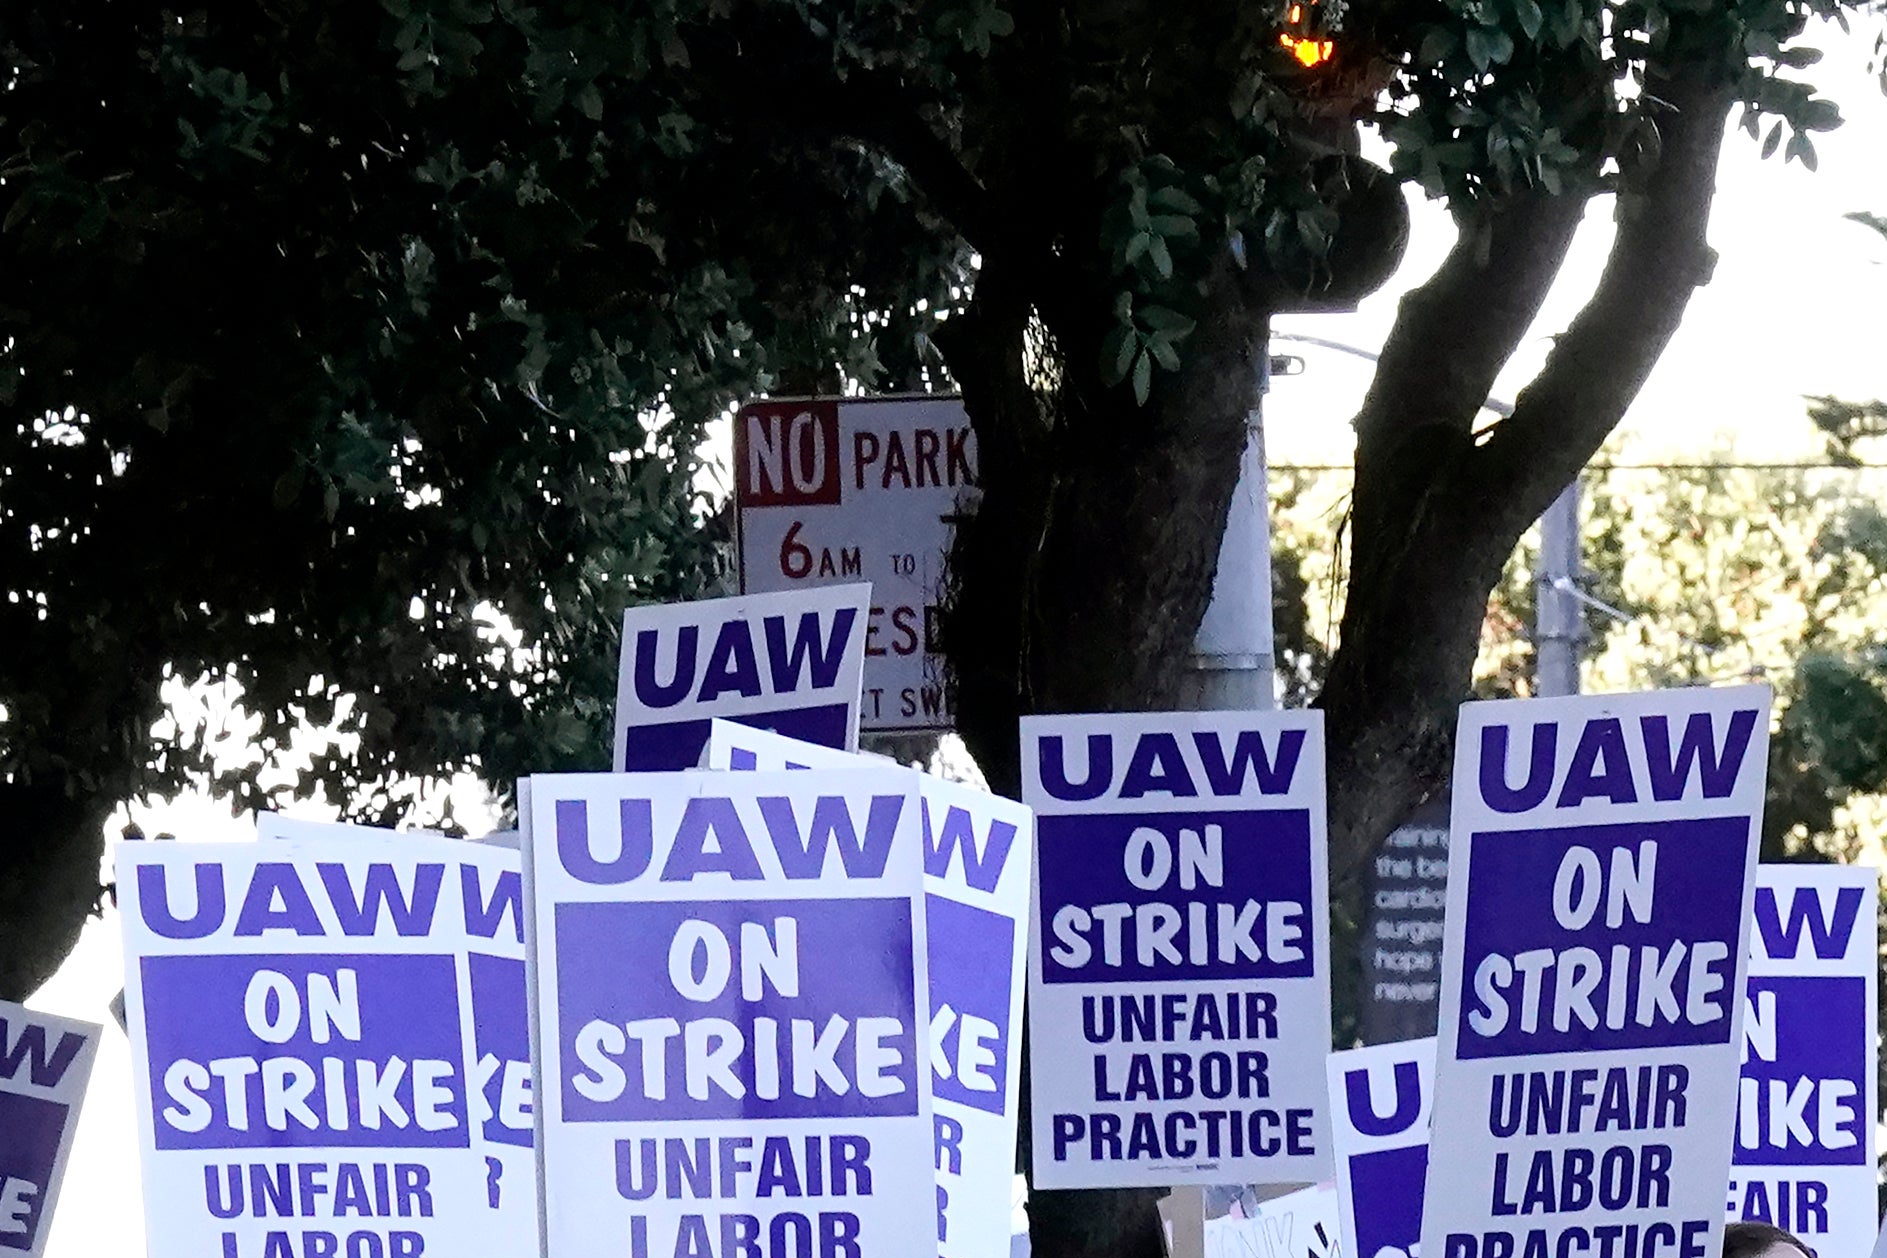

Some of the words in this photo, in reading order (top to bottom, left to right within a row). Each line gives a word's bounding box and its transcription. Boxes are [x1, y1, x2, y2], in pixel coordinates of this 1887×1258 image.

[746, 411, 825, 495] NO
[854, 427, 974, 490] PARK
[779, 521, 861, 580] 6AM
[889, 553, 917, 576] TO
[634, 607, 858, 709] UAW
[1038, 729, 1306, 802] UAW
[1479, 709, 1759, 814] UAW
[555, 794, 906, 885] UAW
[1123, 824, 1224, 892] ON
[137, 862, 446, 940] UAW
[1553, 839, 1658, 930] ON
[668, 915, 800, 1003] ON
[1049, 898, 1305, 970] STRIKE
[244, 968, 362, 1045] ON
[1082, 991, 1279, 1043] UNFAIR
[1469, 938, 1728, 1038] STRIKE
[162, 1054, 459, 1133] STRIKE
[571, 1015, 906, 1101] STRIKE
[1093, 1050, 1271, 1103] LABOR
[1053, 1108, 1316, 1162] PRACTICE
[1488, 1064, 1689, 1139] UNFAIR
[203, 1162, 435, 1219] UNFAIR
[614, 1134, 873, 1200] UNFAIR
[1491, 1144, 1672, 1217] LABOR
